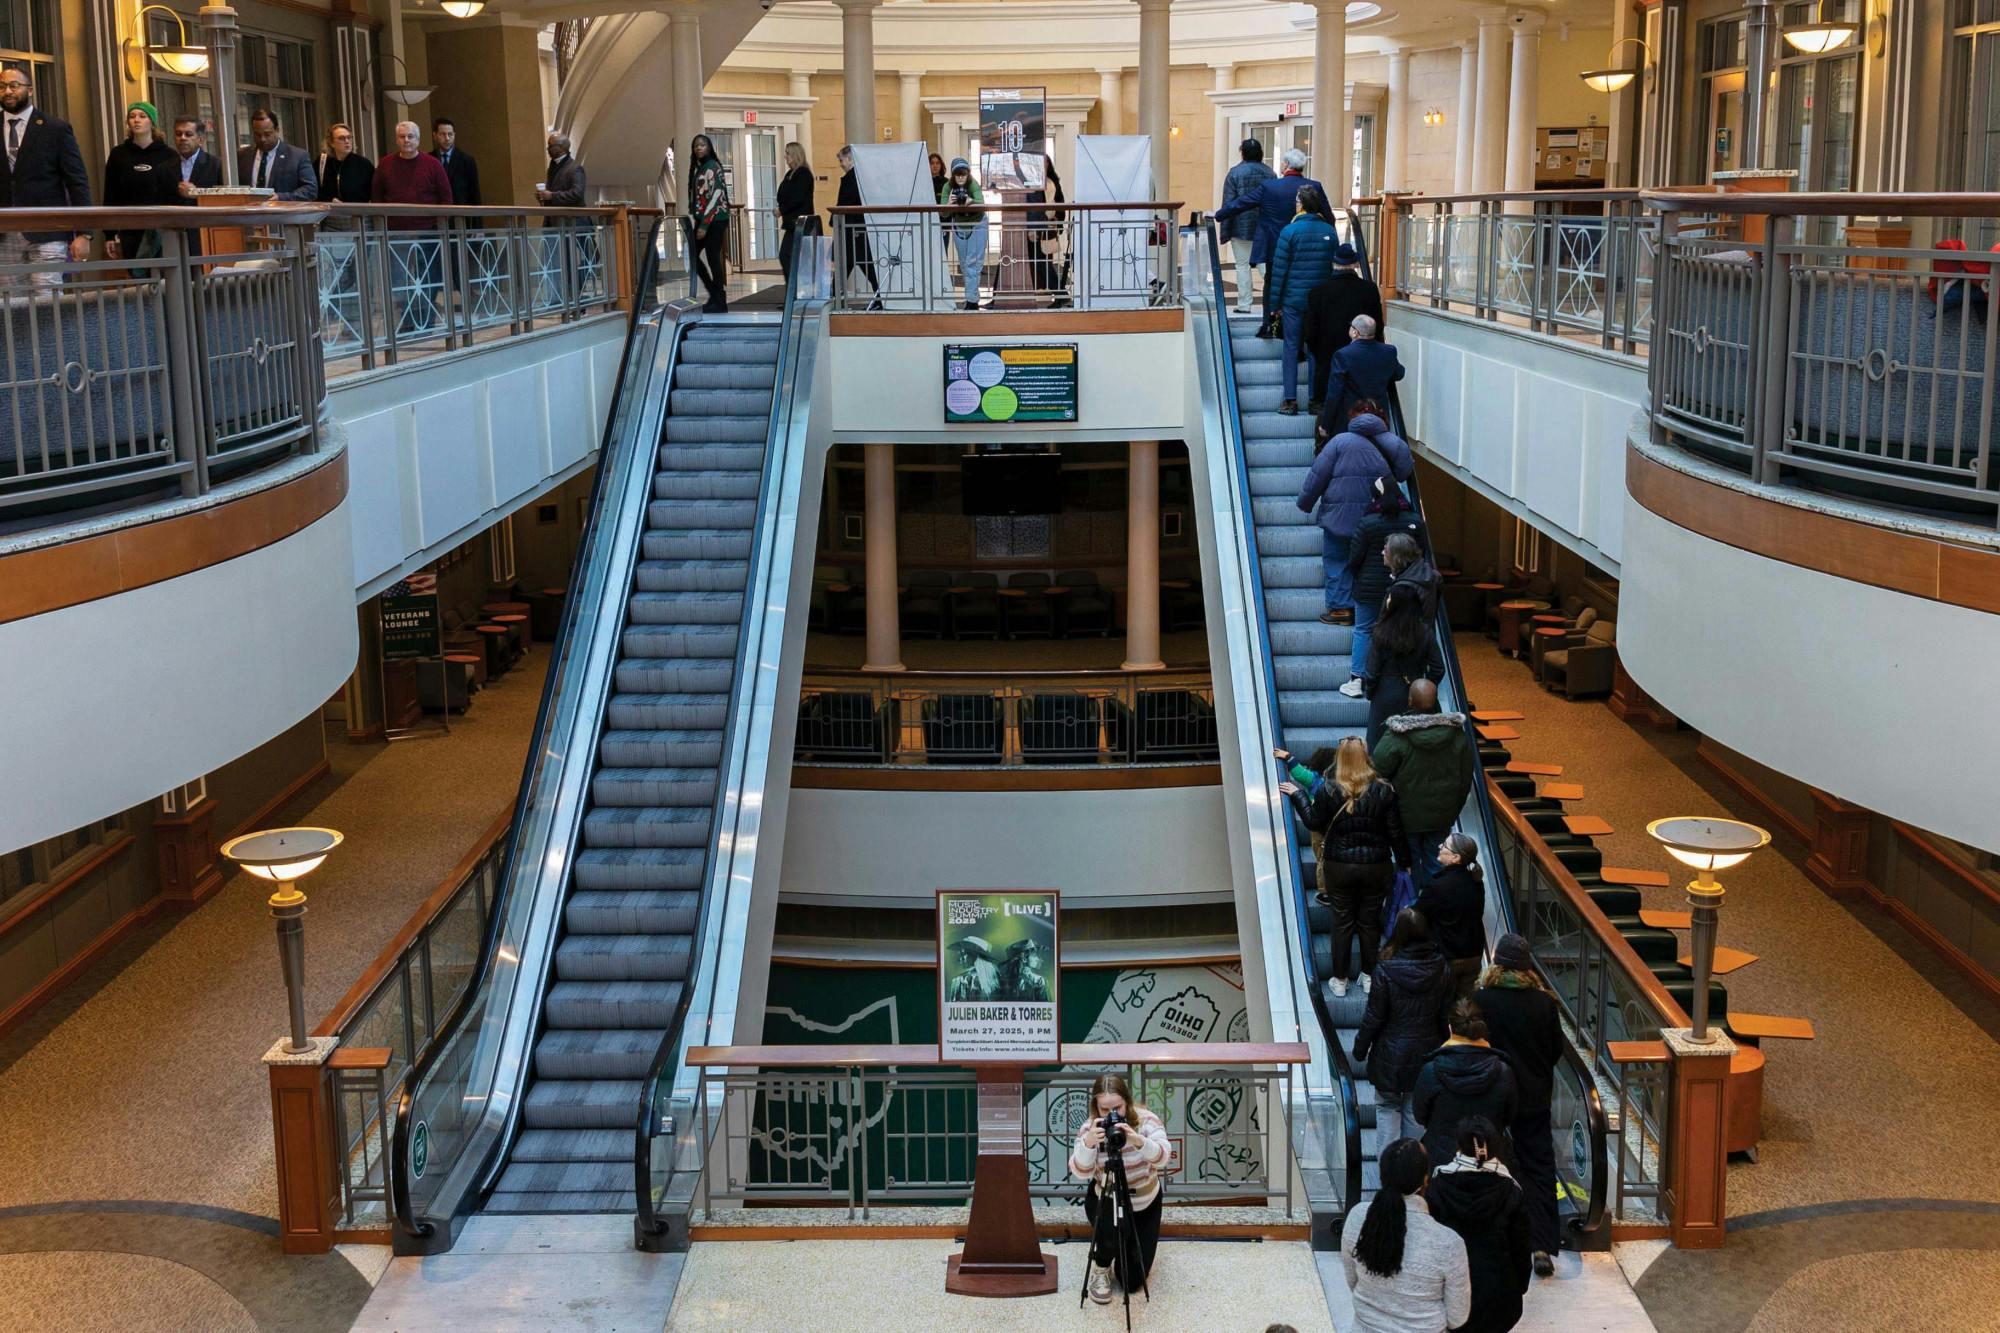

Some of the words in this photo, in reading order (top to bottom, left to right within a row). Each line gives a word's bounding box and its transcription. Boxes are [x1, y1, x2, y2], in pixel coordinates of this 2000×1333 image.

[998, 121, 1023, 152] 10
[384, 610, 430, 620] VETERANS
[385, 619, 420, 629] LOUNGE
[948, 1007, 978, 1020] JULIEN
[980, 1007, 1009, 1020] BAKER
[1010, 1007, 1017, 1020] &
[1019, 1007, 1053, 1020] TORRES
[1165, 1007, 1205, 1031] OHIO
[1159, 1020, 1199, 1041] FOREVER
